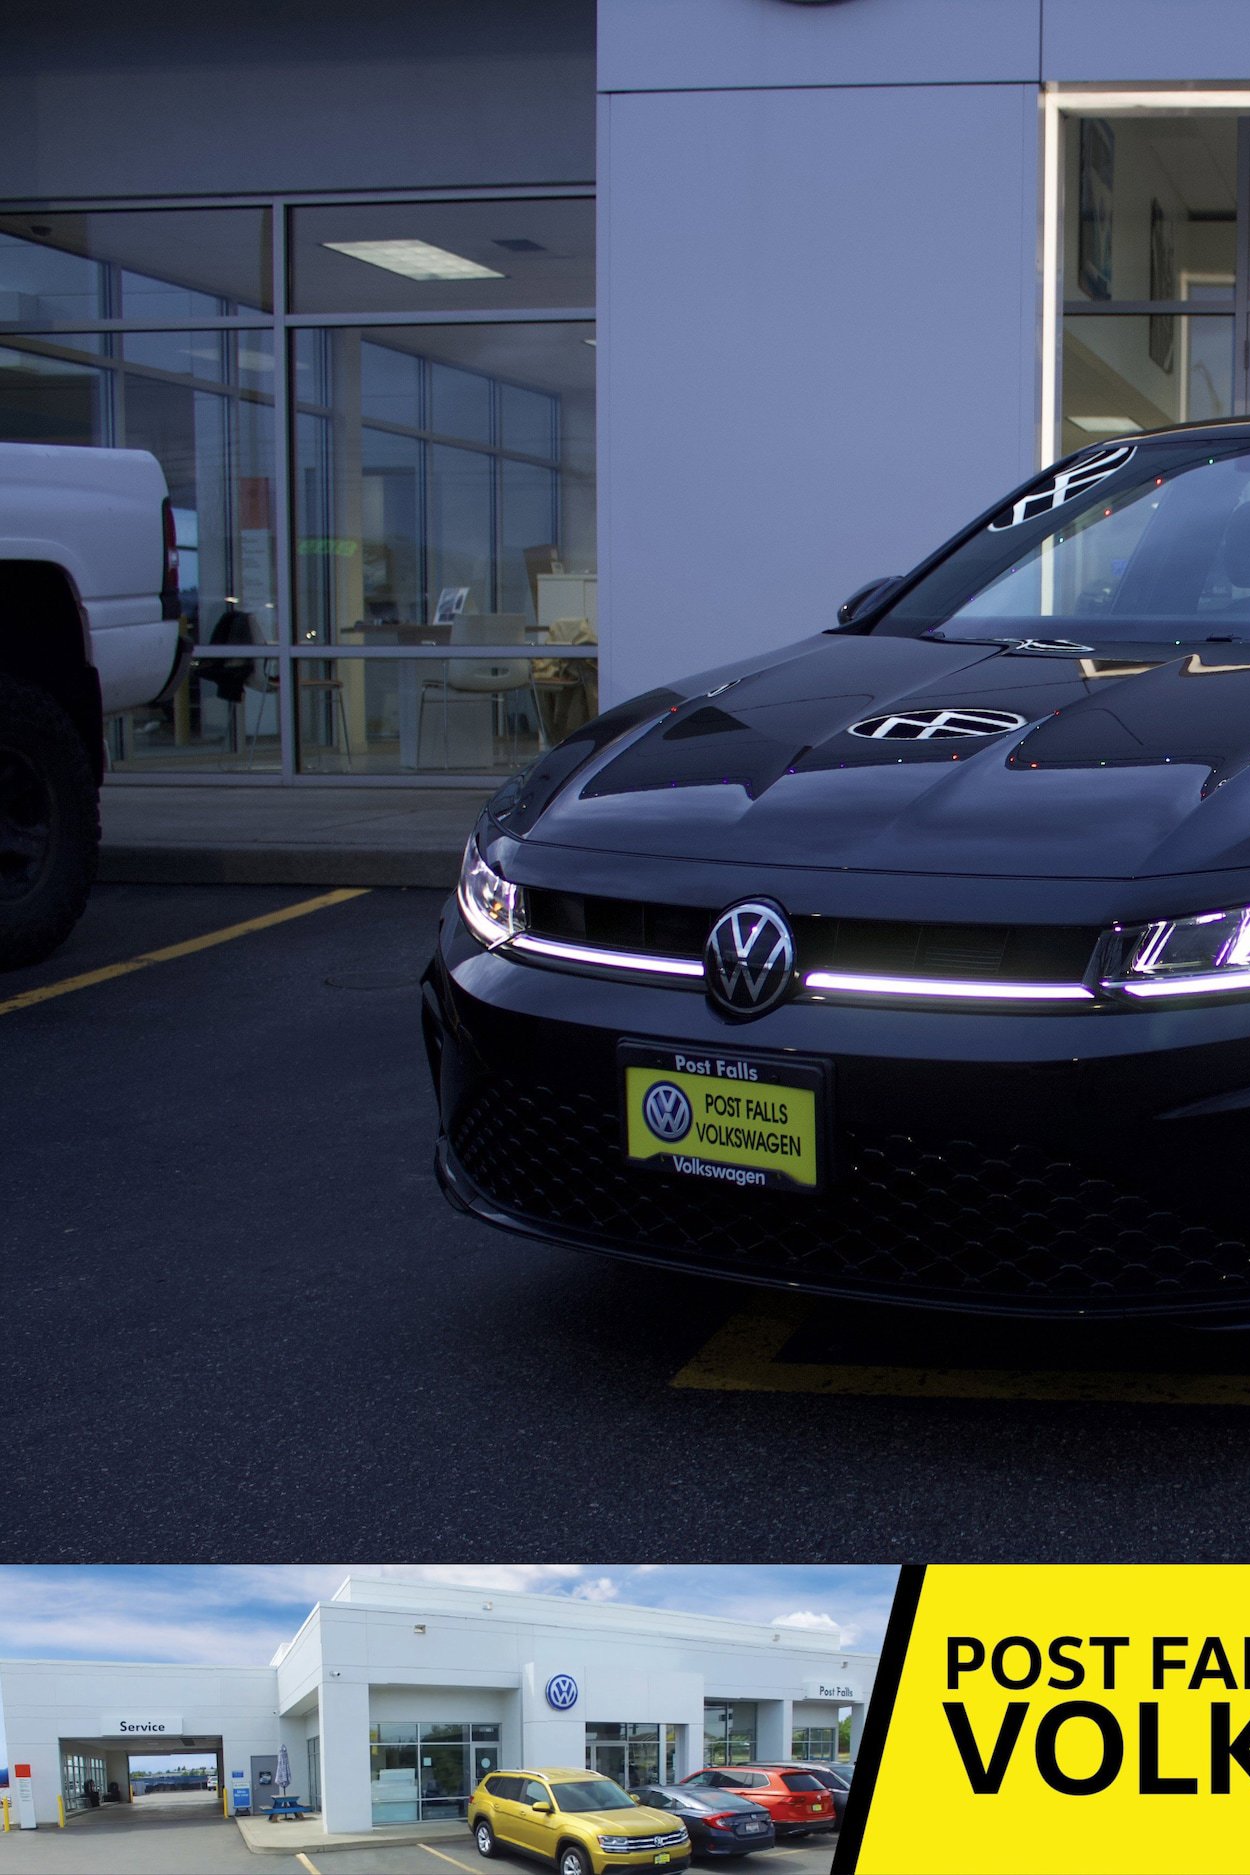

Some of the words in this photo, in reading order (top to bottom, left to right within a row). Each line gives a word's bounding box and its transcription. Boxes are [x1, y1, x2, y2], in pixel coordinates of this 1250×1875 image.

[675, 1055, 711, 1075] Post
[716, 1059, 759, 1081] Falls
[705, 1093, 741, 1118] POST
[746, 1099, 788, 1125] FALLS
[696, 1121, 802, 1157] VOLKSWAGEN
[673, 1154, 766, 1185] Volkswagen
